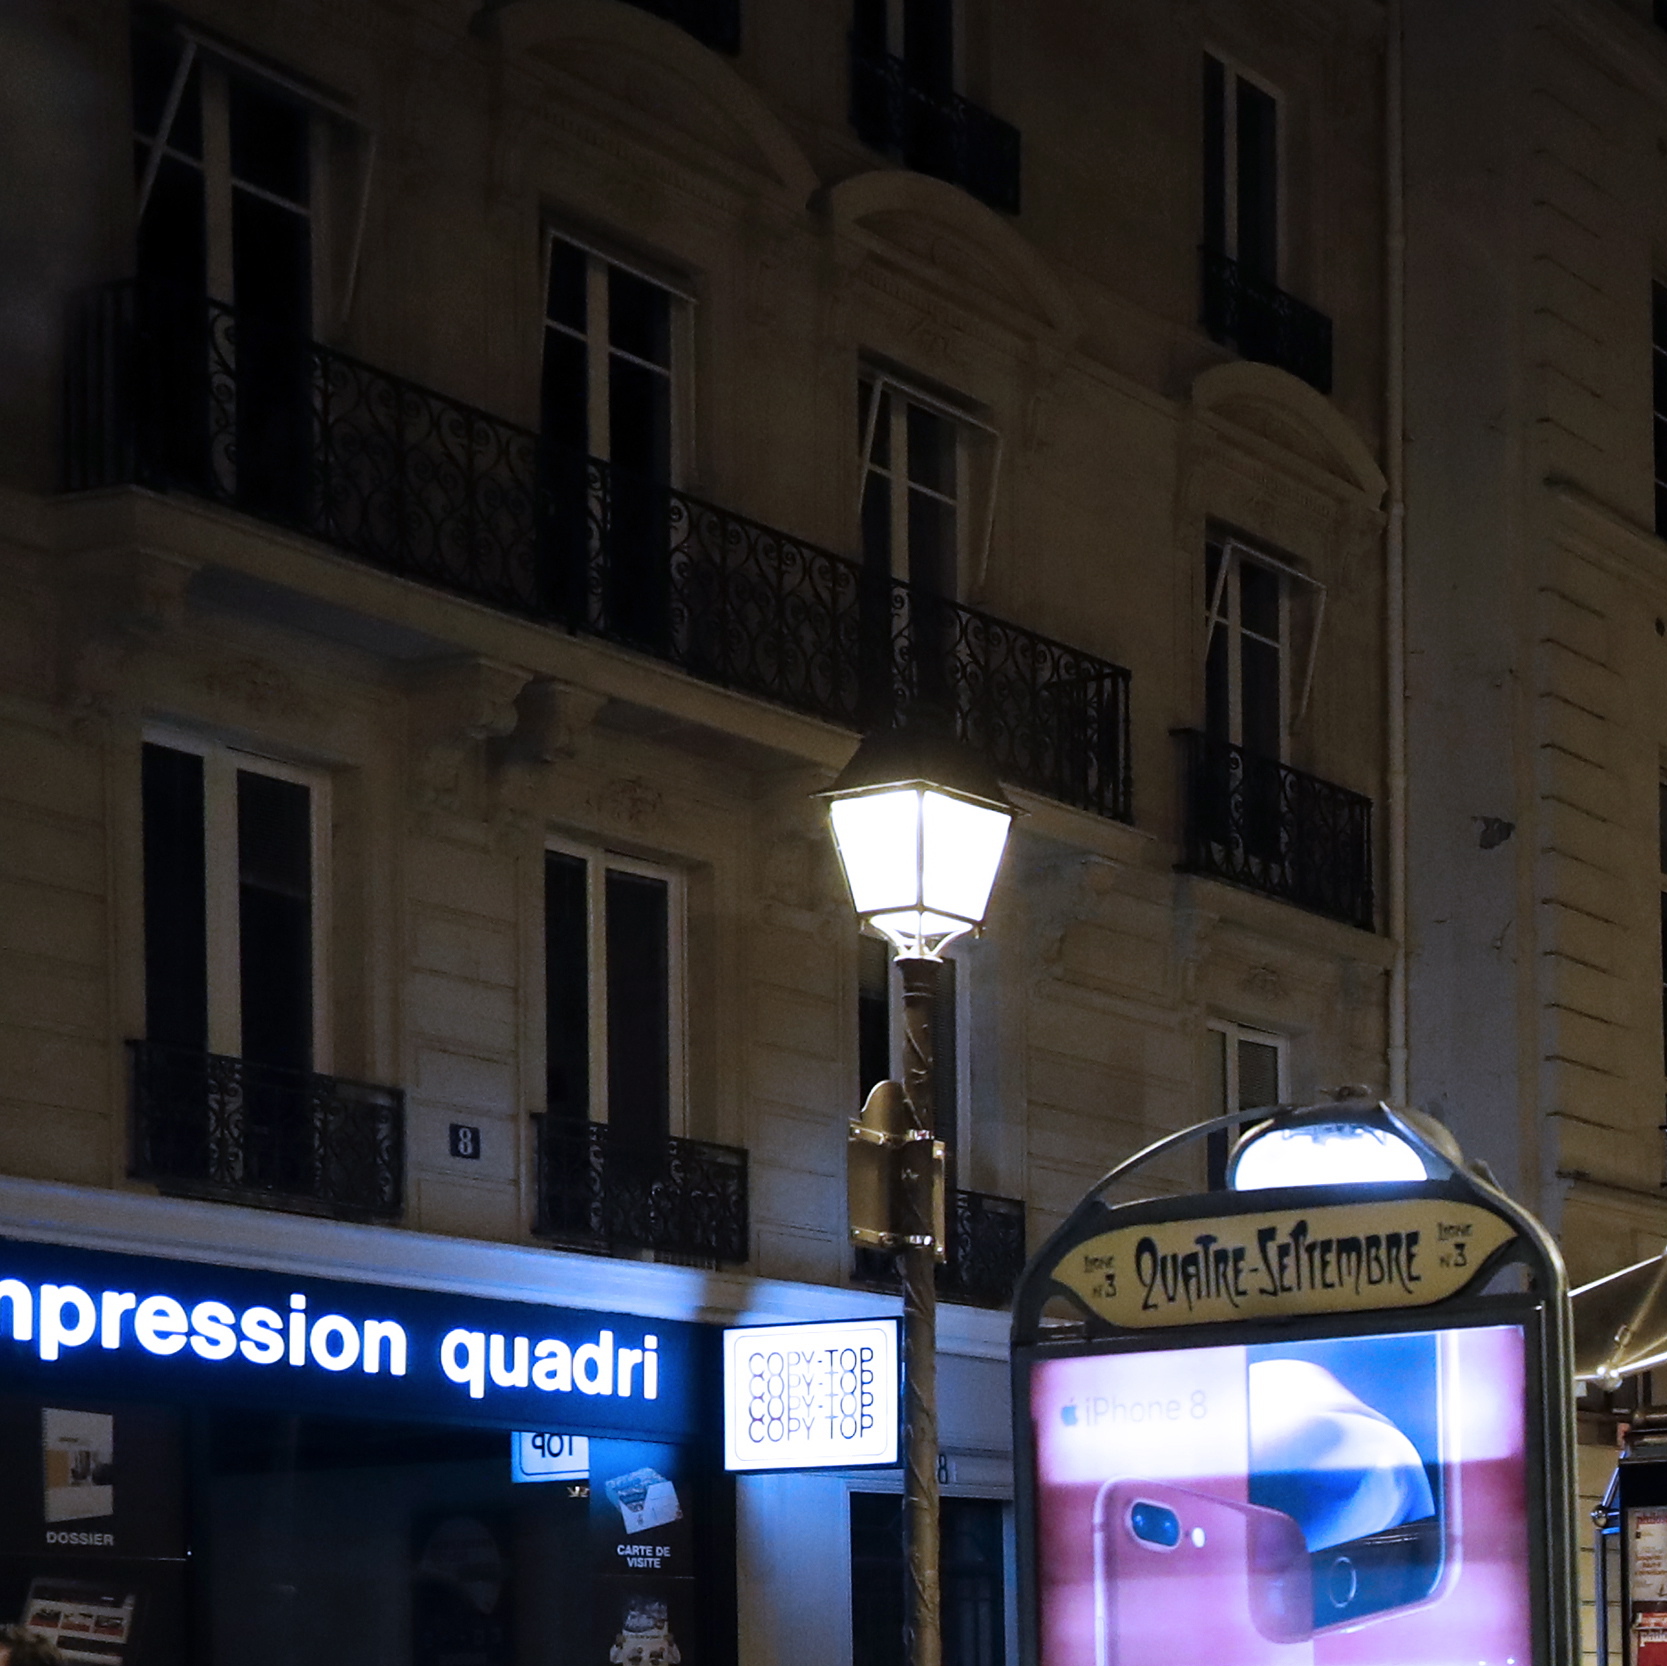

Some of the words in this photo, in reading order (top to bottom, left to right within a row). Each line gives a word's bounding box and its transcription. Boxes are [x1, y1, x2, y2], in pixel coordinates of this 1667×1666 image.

[458, 1127, 473, 1155] 8
[1454, 1242, 1468, 1268] 3
[1104, 1272, 1117, 1298] 3
[0, 1278, 407, 1376] pression
[440, 1330, 658, 1399] quadri
[748, 1347, 874, 1378] COPY-TOP
[748, 1369, 874, 1399] COPY-TOP
[748, 1391, 874, 1421] COPY-TOP
[1085, 1394, 1182, 1427] iPhone
[1189, 1390, 1208, 1420] 8
[748, 1417, 816, 1443] COPY
[824, 1413, 874, 1440] TOP
[46, 1530, 115, 1546] DOSSIER
[616, 1544, 654, 1557] CARTE
[655, 1545, 671, 1558] DE
[626, 1556, 662, 1569] VISITE
